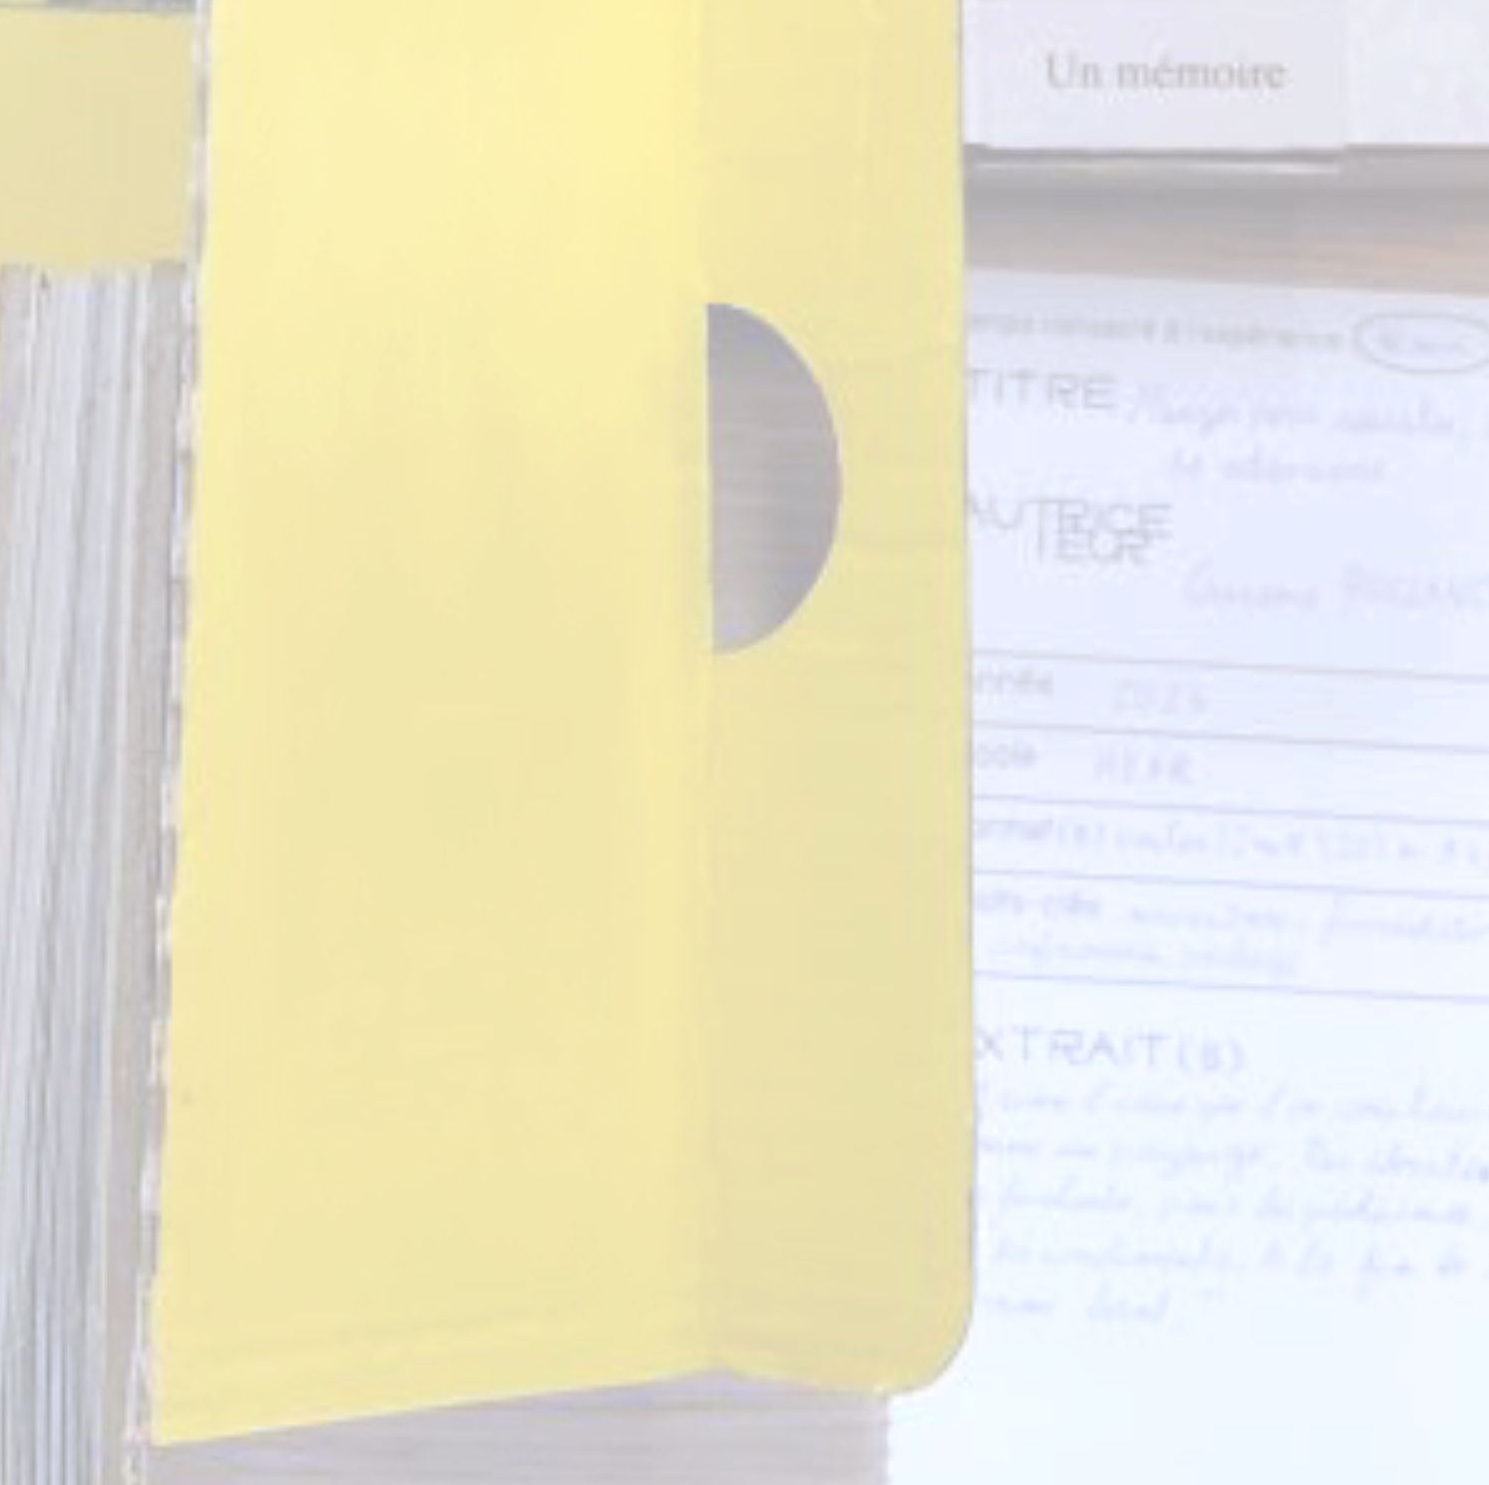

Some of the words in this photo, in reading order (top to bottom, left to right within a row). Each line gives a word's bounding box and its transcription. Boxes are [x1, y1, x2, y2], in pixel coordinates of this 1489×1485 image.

[1043, 51, 1104, 92] Un
[1113, 51, 1290, 92] mémoire
[964, 368, 1117, 410] TITRE
[976, 741, 1037, 769] cole
